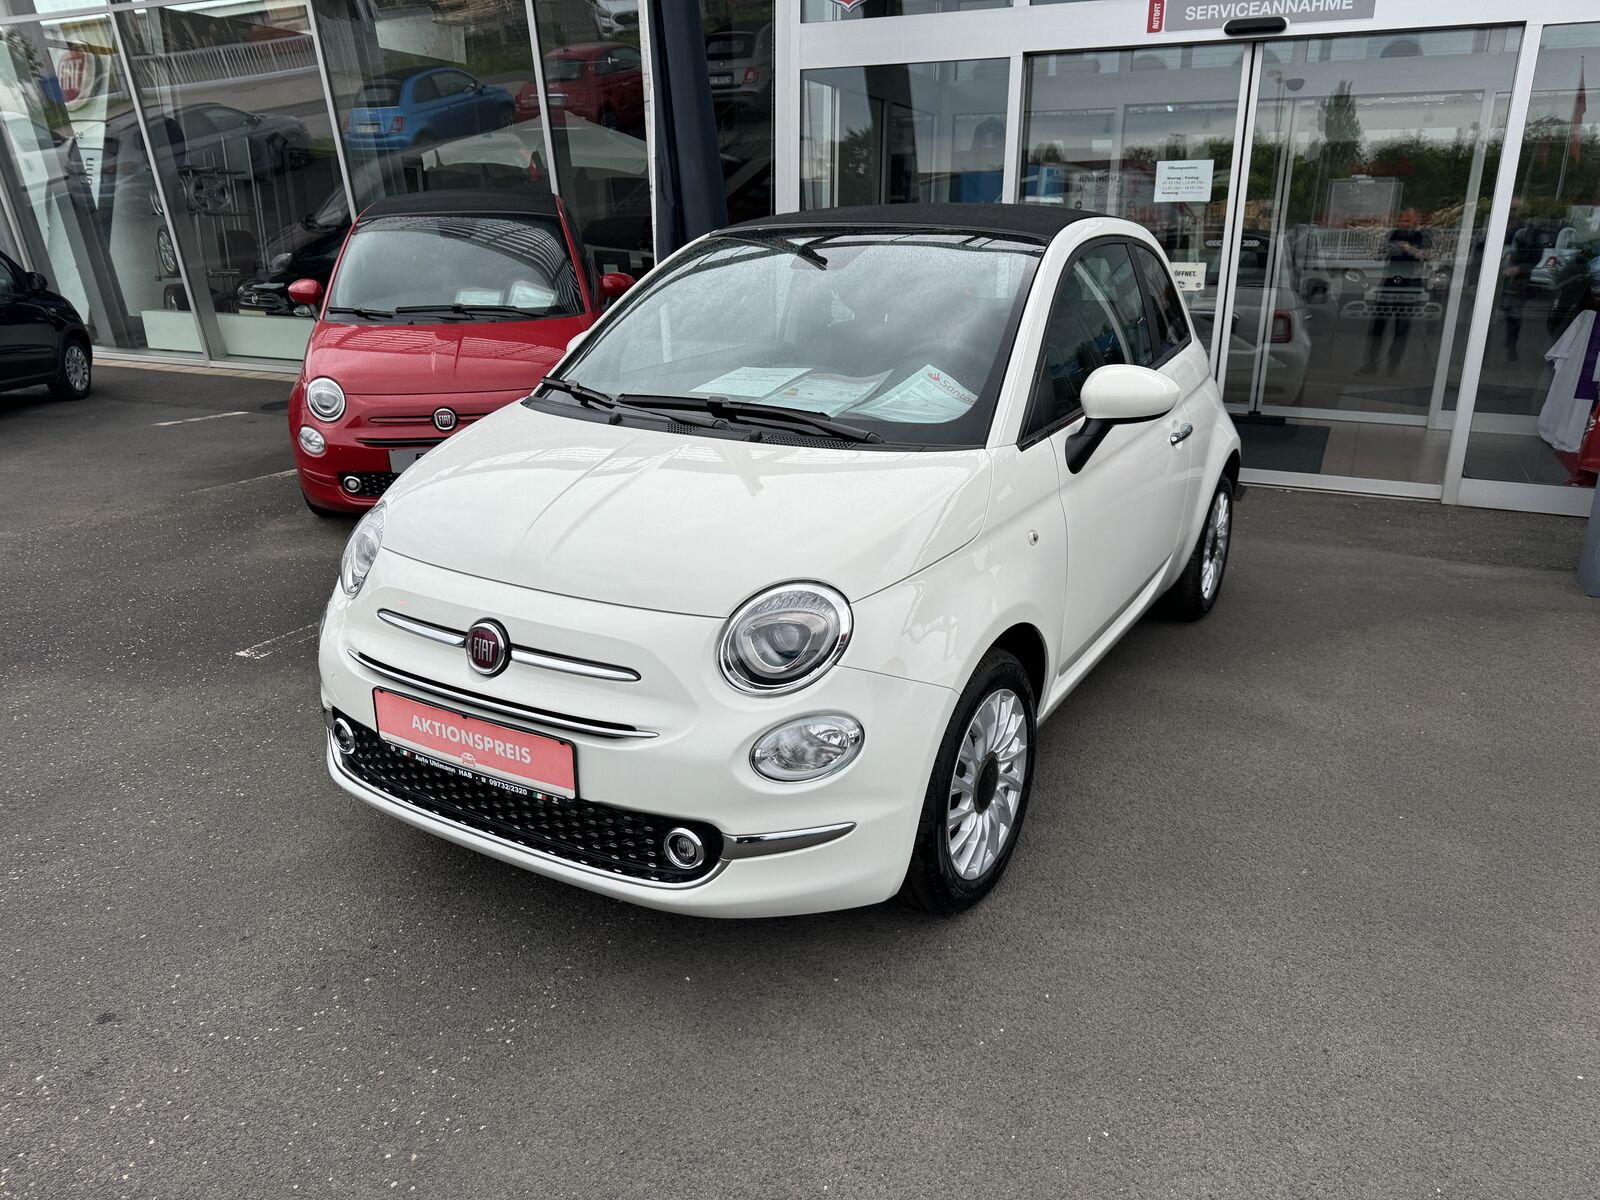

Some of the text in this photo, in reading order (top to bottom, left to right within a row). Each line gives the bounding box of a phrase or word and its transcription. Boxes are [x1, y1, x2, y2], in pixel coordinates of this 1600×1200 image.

[1152, 2, 1162, 30] AUTOFIT
[1184, 0, 1354, 21] SERVICEANNAHME
[438, 414, 451, 425] FIAT
[473, 636, 496, 662] FIAT
[411, 714, 533, 765] AKTIONSPREIS
[415, 754, 528, 796] Auto Uhlmann HAB 09732/2320
